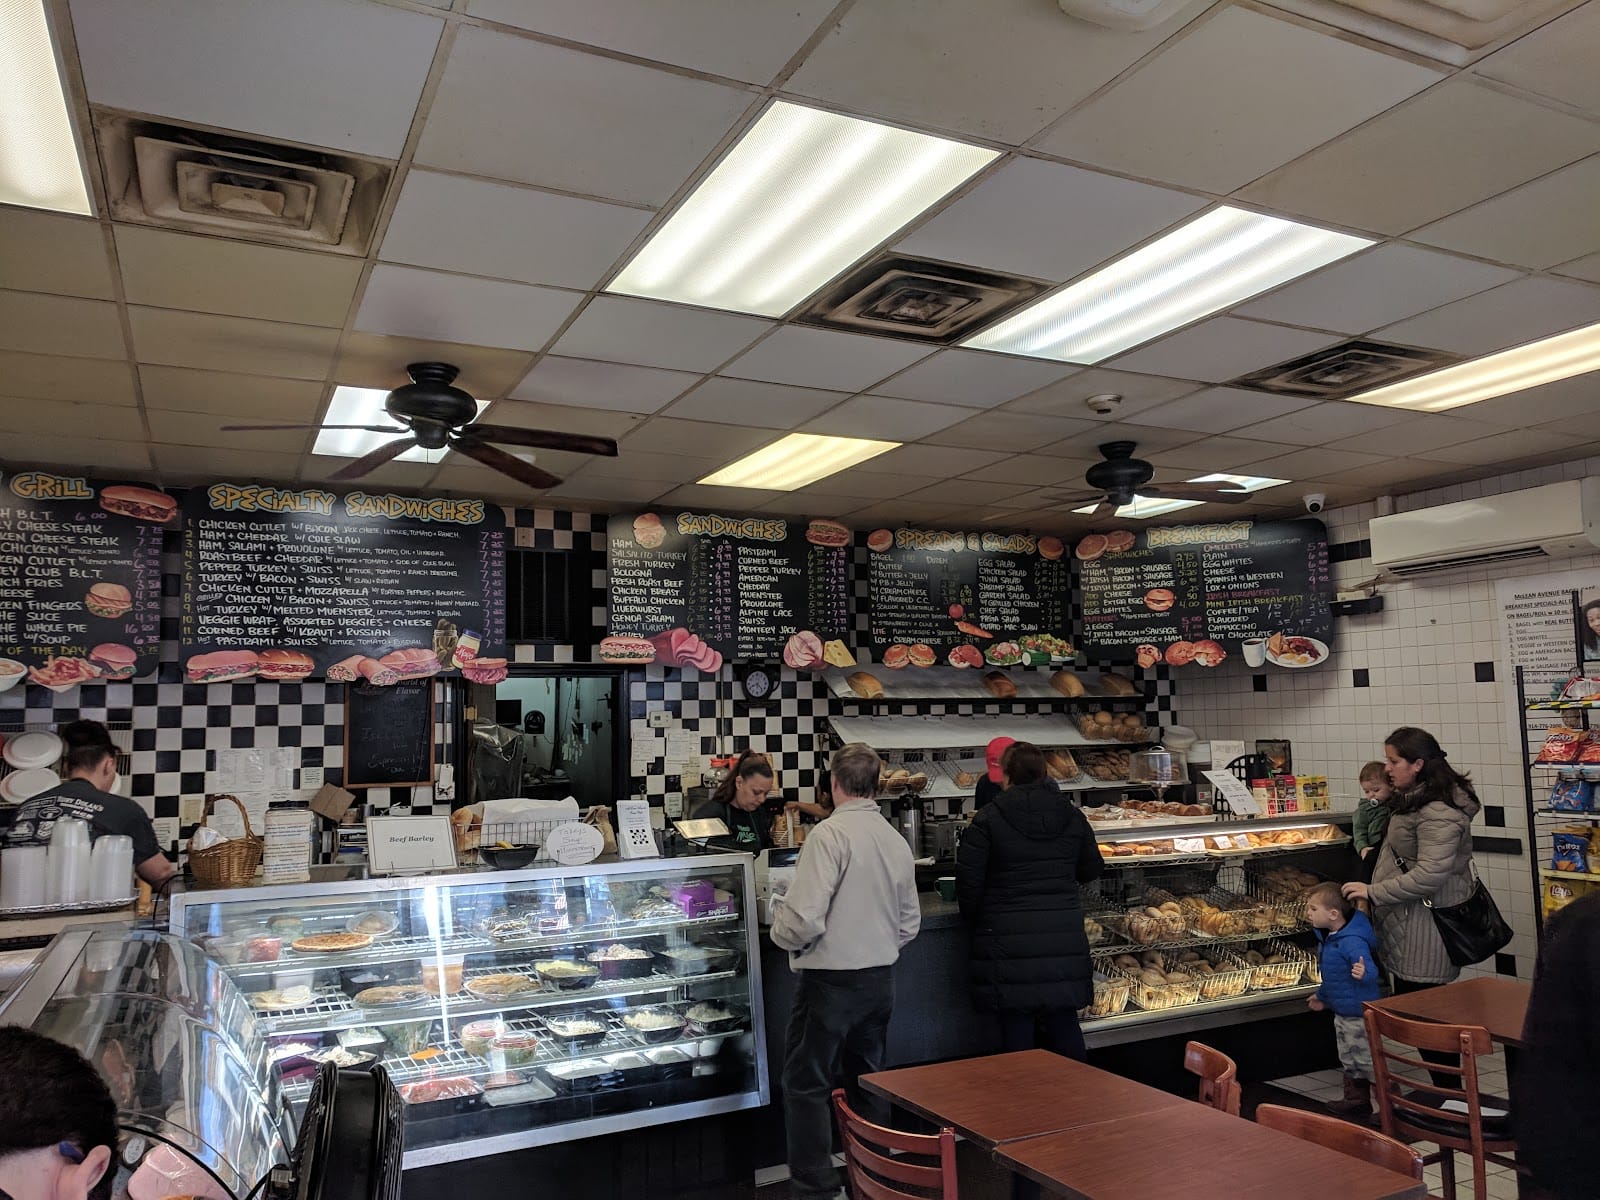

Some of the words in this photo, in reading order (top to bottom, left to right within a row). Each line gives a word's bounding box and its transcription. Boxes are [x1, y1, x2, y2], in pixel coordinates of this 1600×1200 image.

[17, 523, 61, 531] CHEESE
[62, 525, 103, 534] STEAK
[198, 520, 246, 530] CHICKEN
[249, 523, 286, 531] CUTLET
[31, 534, 74, 543] CHEESE
[80, 536, 119, 546] STEAK
[200, 530, 226, 539] HAM
[237, 533, 289, 541] CHEDDAR
[308, 535, 331, 543] COLE
[333, 536, 361, 544] SLAW
[1147, 522, 1253, 549] BREAKFAST
[228, 542, 266, 551] SALAMI
[612, 539, 633, 548] HAM
[981, 532, 1037, 554] SALADS
[3, 543, 58, 554] CHICKEN
[738, 547, 776, 557] PASTRAMI
[29, 556, 76, 565] CUTLET
[274, 555, 323, 564] CHEDDAR
[871, 553, 893, 561] BAGEL
[1203, 552, 1227, 560] PLAIN
[612, 559, 640, 567] FRESH
[643, 560, 675, 569] TURKEY
[769, 558, 789, 566] BEEF
[978, 559, 993, 567] EGG
[995, 560, 1016, 568] SALAD
[1203, 560, 1220, 568] EGG
[1222, 558, 1253, 566] WHITES
[25, 567, 61, 576] CLUB
[198, 562, 242, 571] PEPPER
[246, 564, 288, 573] TURKEY
[299, 566, 333, 574] SWISS
[773, 567, 802, 575] TURKEY
[1203, 568, 1235, 576] CHEESE
[613, 569, 652, 577] BOLOGNA
[738, 573, 778, 582] AMERICAN
[878, 571, 904, 579] BUTTER
[909, 572, 928, 580] JELLY
[1246, 572, 1284, 580] WESTERN
[24, 579, 63, 587] FRIES
[198, 574, 242, 582] TURKEY
[259, 575, 297, 583] BACON
[308, 577, 341, 585] SWISS
[638, 578, 661, 586] ROAST
[199, 584, 251, 593] CHICKEN
[255, 585, 293, 594] CUTLET
[612, 587, 646, 595] CHICKEN
[651, 588, 680, 596] BREAST
[225, 595, 270, 604] CHICKEN
[289, 596, 325, 605] BACON
[614, 596, 647, 604] BUFFALO
[740, 591, 783, 600] MUENSTER
[979, 591, 1005, 599] GARDEN
[1008, 592, 1030, 600] SALAD
[27, 602, 82, 610] FINGERS
[1206, 600, 1225, 608] MINI
[1254, 595, 1304, 605] BREAKFAST
[214, 606, 257, 614] TURKEY
[273, 606, 313, 615] MELTED
[739, 609, 769, 617] ALPINE
[773, 609, 793, 617] LACE
[27, 613, 61, 621] SLICE
[283, 617, 335, 626] ASSORTED
[612, 614, 642, 622] GENOA
[646, 615, 674, 623] SALAMI
[27, 624, 63, 632] WHOLE
[68, 624, 87, 632] PIE
[197, 626, 243, 635] CORNED
[248, 626, 280, 635] BEEF
[299, 628, 333, 636] KRAUT
[346, 628, 391, 637] RUSSIAN
[779, 626, 797, 634] JACK
[1145, 627, 1177, 635] SAUSAGE
[216, 637, 274, 646] PASTRAMI
[284, 638, 318, 646] SWISS
[8, 647, 23, 655] OF
[61, 647, 86, 656] DAY
[411, 835, 435, 843] Barley
